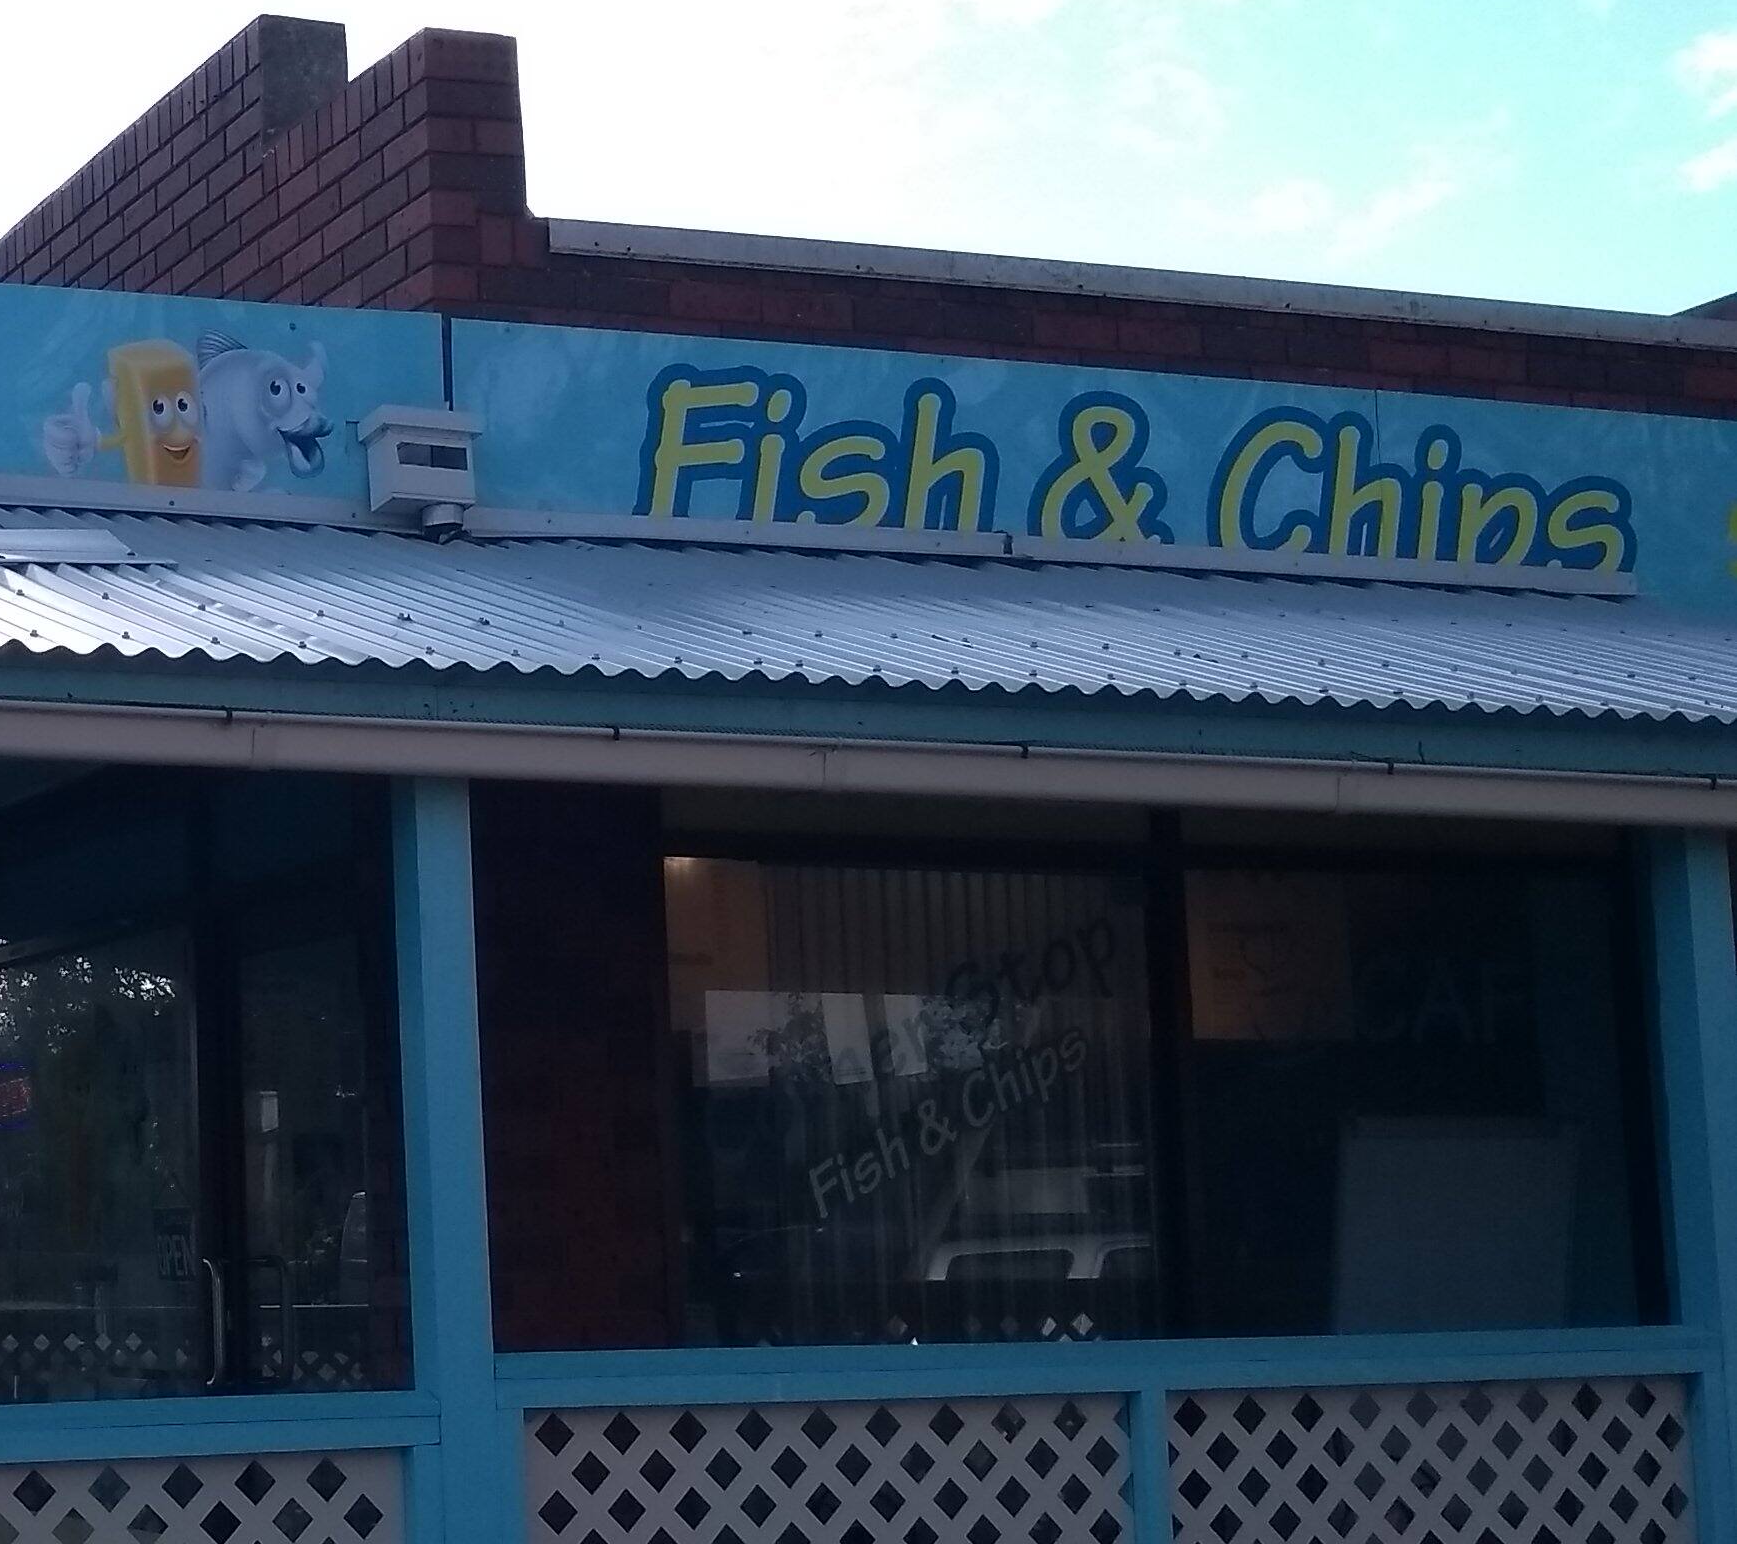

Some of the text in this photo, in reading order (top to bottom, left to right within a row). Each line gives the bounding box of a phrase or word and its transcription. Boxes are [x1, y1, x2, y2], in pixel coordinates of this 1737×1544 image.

[633, 363, 1000, 533] Fish
[1027, 390, 1174, 544] &
[944, 916, 1117, 1034] Stop
[808, 1027, 1089, 1220] Fish & Chips
[157, 1233, 196, 1278] OPEN
